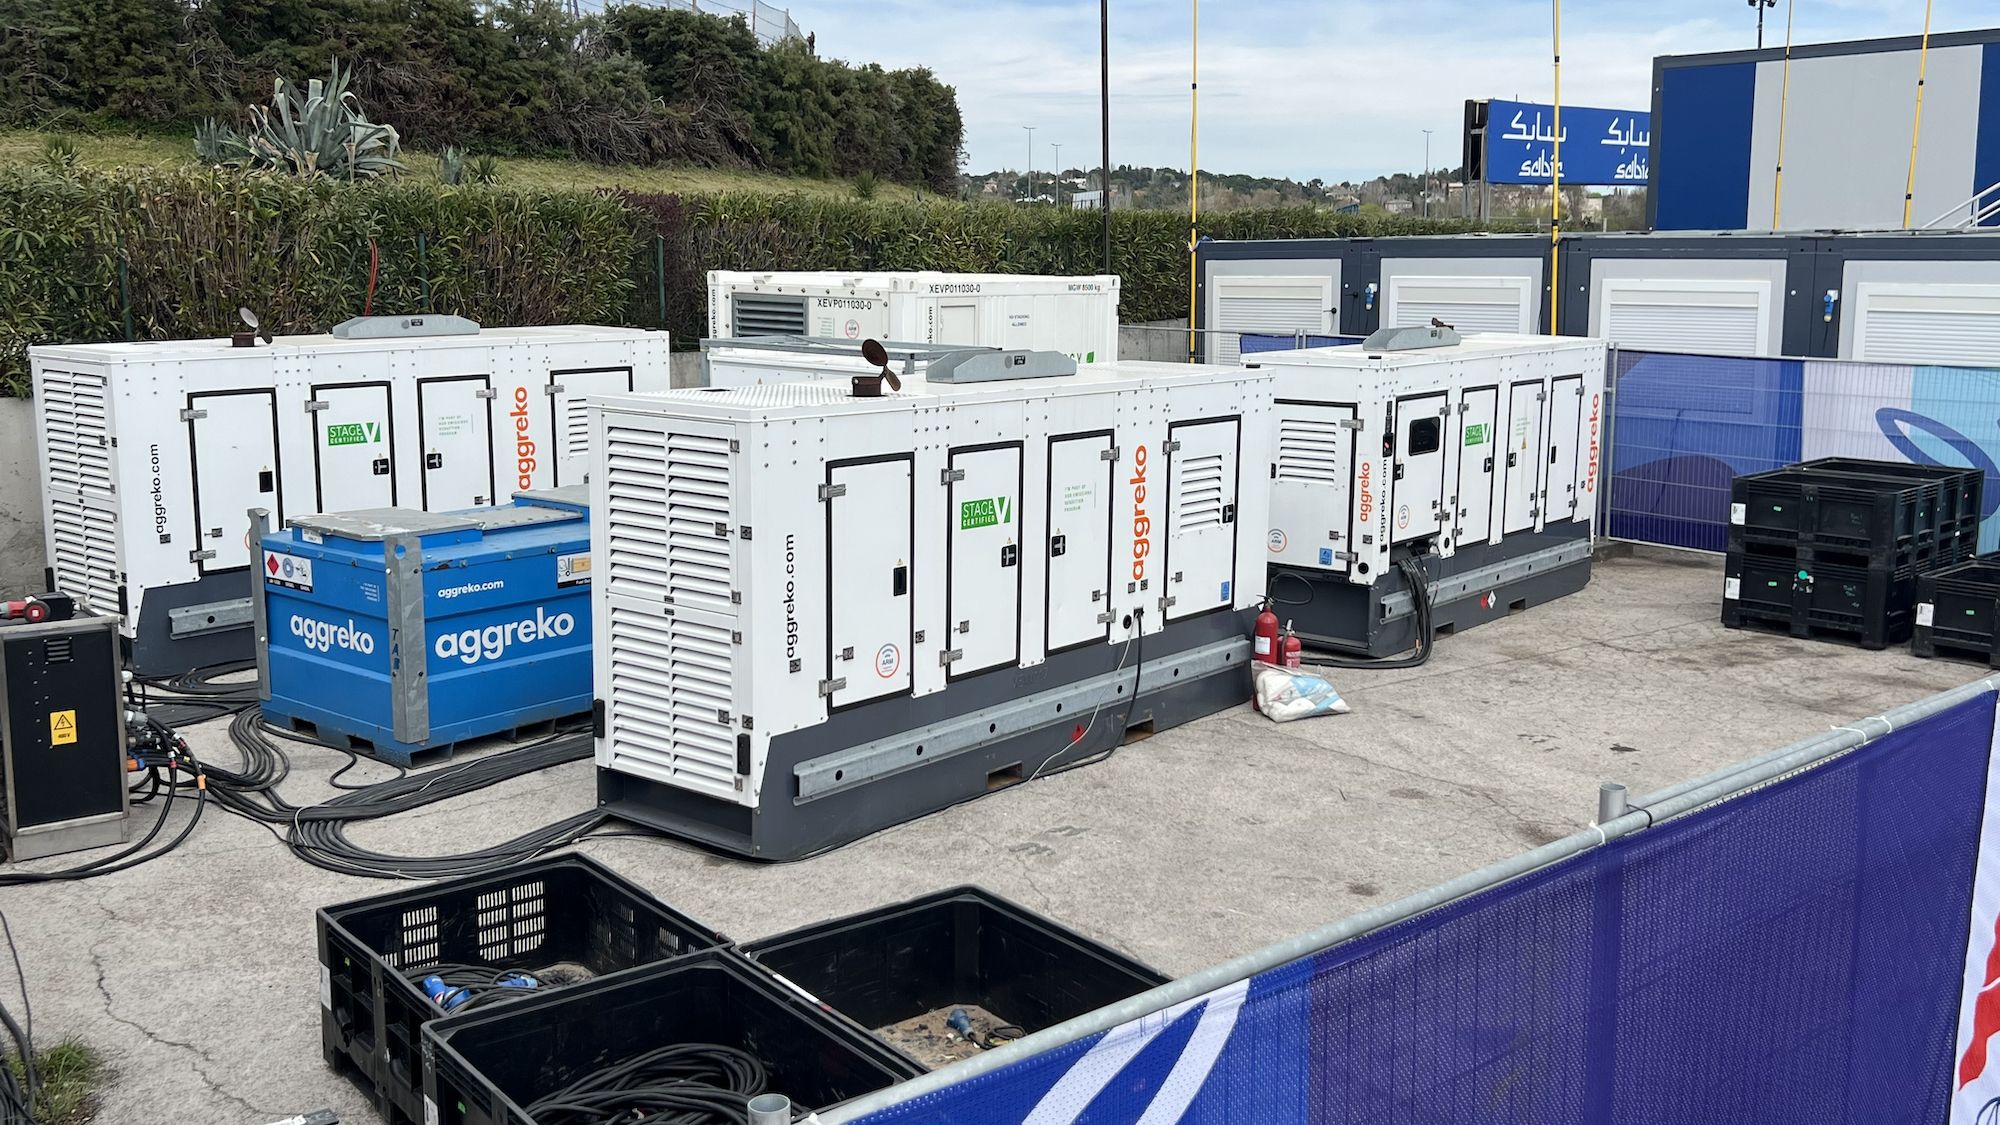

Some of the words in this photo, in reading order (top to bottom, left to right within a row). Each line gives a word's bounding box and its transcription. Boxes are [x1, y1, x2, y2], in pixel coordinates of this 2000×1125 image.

[817, 298, 872, 311] XEVP011030-0
[928, 283, 981, 294] XEVP011030-0
[710, 288, 718, 339] ggreko.com
[329, 425, 362, 438] STAGE
[330, 435, 365, 444] CERTIFIED
[510, 386, 537, 490] aggreko
[1465, 426, 1482, 438] STAGE
[1587, 393, 1600, 493] aggreko
[151, 443, 166, 534] aggreko.com
[962, 501, 994, 518] STAGE
[1358, 462, 1371, 522] aggreko
[1379, 459, 1389, 543] aggreko.com
[962, 515, 996, 527] CERTIFIED
[1130, 444, 1151, 580] aggreko
[438, 579, 504, 599] aggreko.com
[783, 533, 798, 659] aggreko.com
[290, 613, 375, 655] aggreko
[434, 606, 575, 665] aggreko
